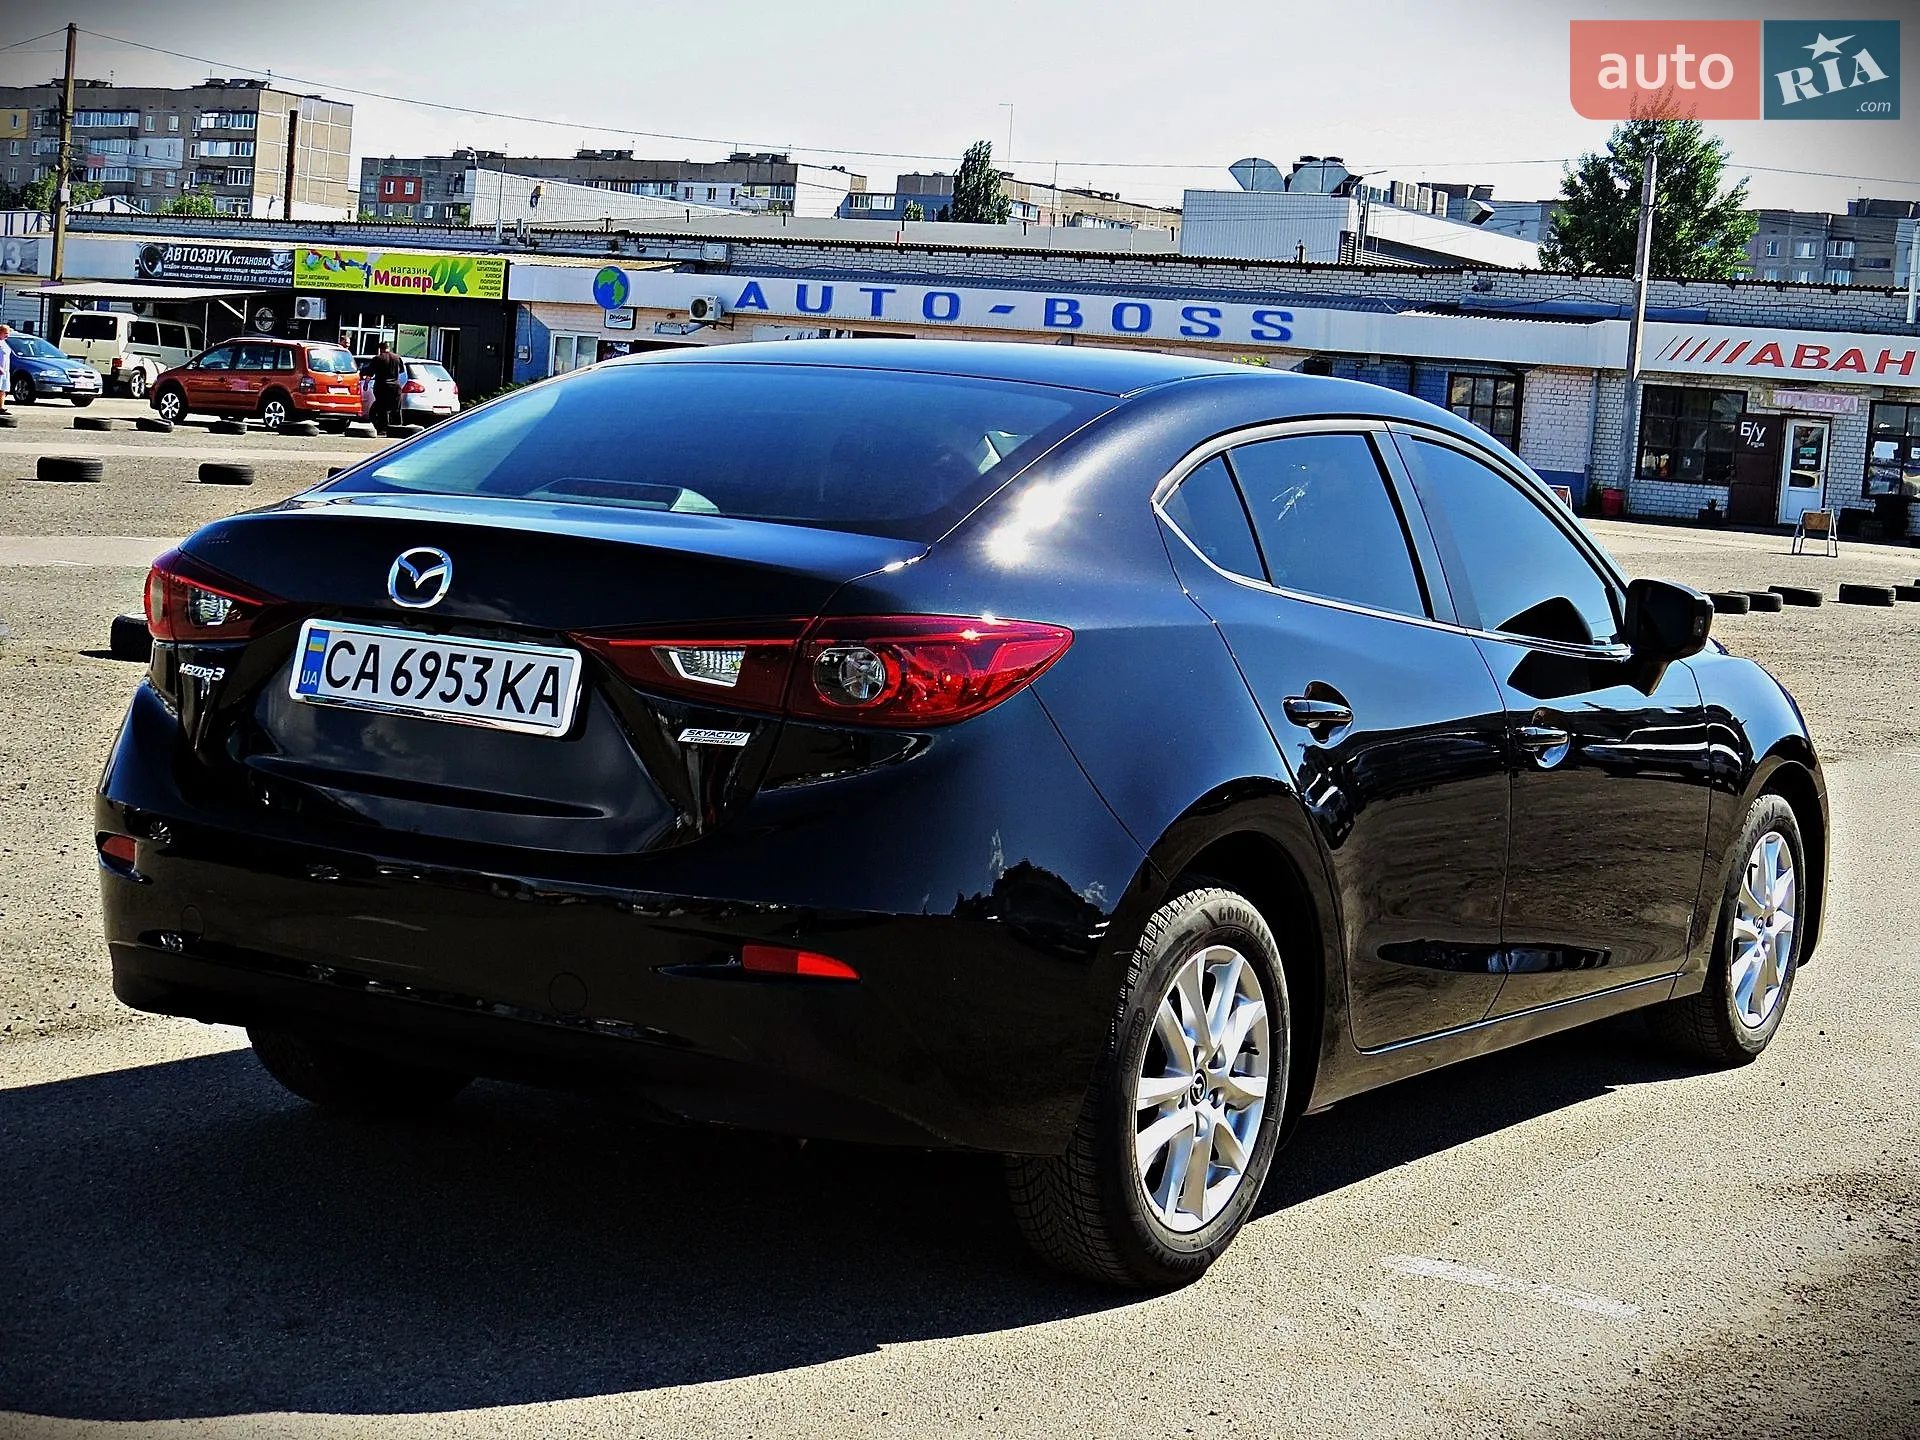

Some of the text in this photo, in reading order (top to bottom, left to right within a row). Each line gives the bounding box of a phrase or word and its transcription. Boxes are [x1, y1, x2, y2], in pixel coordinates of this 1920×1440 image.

[164, 246, 271, 267] АВТОЗВУК УСТАНОВКА
[390, 266, 428, 275] магазин
[1760, 390, 1858, 413] ТОРАЗБОРКА
[301, 670, 318, 686] UA
[325, 640, 559, 718] CA 6953 KA
[686, 729, 743, 740] SKYACTIV
